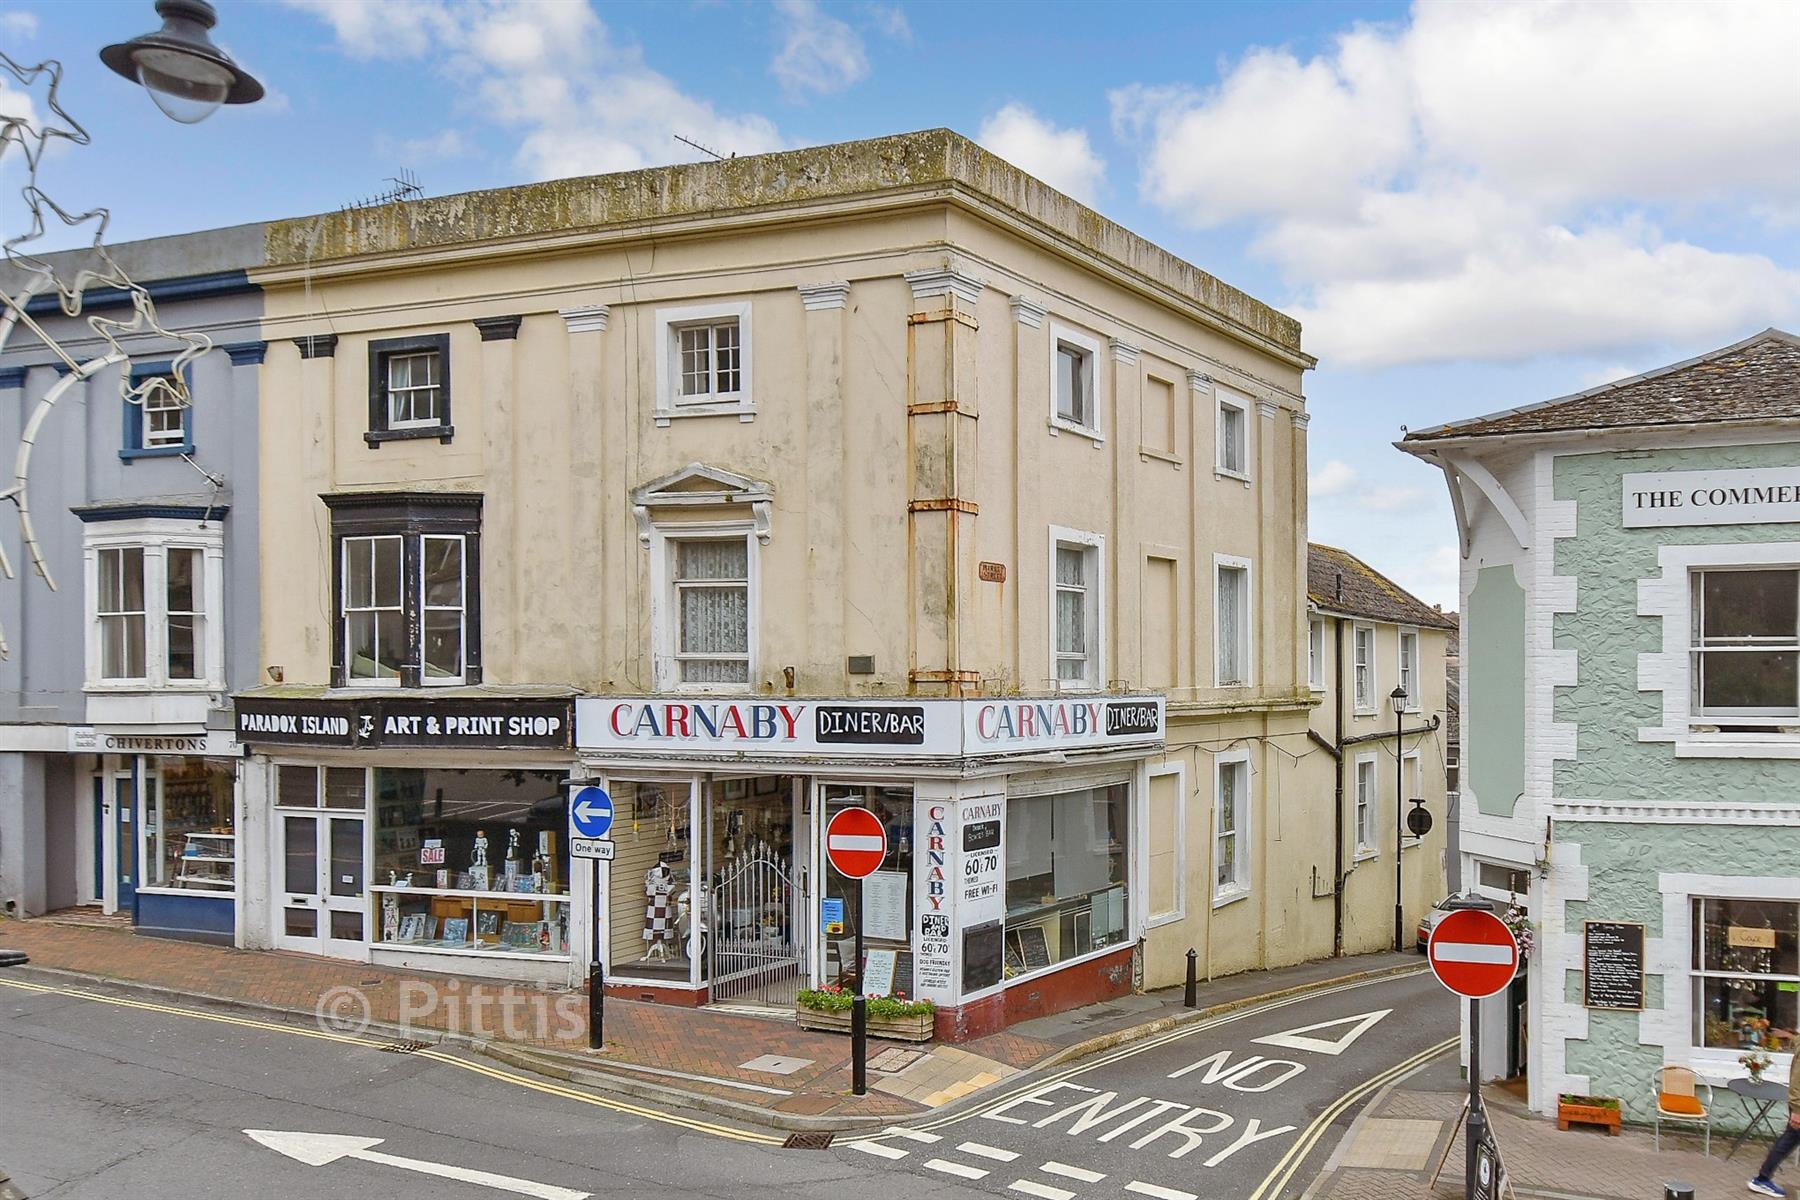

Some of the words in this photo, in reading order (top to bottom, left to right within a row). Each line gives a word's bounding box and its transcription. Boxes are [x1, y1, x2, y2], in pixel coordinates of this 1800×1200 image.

[1632, 490, 1683, 508] THE
[240, 713, 298, 733] PARADOX
[301, 715, 349, 735] ISLAND
[384, 716, 421, 735] ART
[425, 716, 441, 735] &
[446, 716, 504, 735] PRINT
[508, 716, 561, 736] SHOP
[610, 703, 807, 740] CARNABY
[818, 710, 924, 736] DINER/BAR
[978, 702, 1103, 740] CARNABY
[1107, 706, 1158, 732] DINER/BAR
[105, 737, 207, 751] CHIVERTONS
[962, 803, 1002, 821] CARNABY
[422, 848, 444, 863] SALE
[575, 843, 592, 853] One
[594, 846, 611, 856] way
[927, 806, 945, 911] CARNABY
[964, 887, 979, 900] FREE
[981, 884, 998, 896] WI-FI
[925, 927, 942, 936] BAR
[931, 924, 946, 932] AND
[1167, 1051, 1307, 1092] NO
[980, 1081, 1297, 1167] ENTRY
